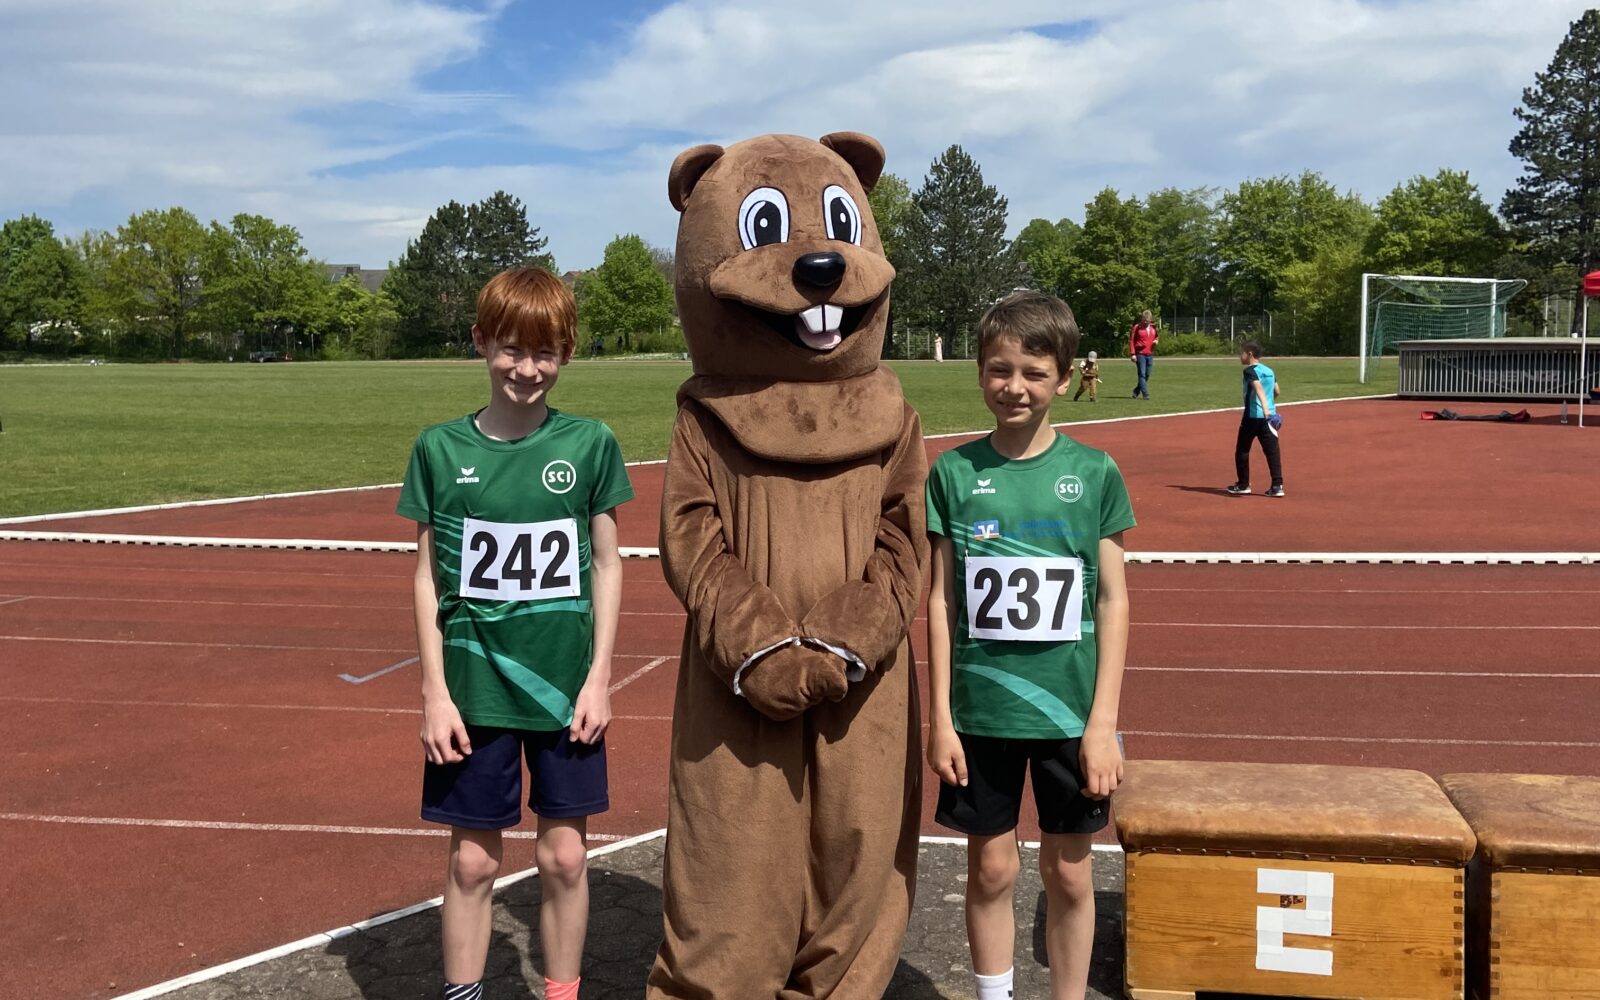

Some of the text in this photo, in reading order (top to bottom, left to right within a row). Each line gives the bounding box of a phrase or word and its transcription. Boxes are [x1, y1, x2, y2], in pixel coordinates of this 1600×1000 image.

[548, 471, 570, 483] SCI
[1059, 483, 1079, 495] SCI
[469, 530, 571, 590] 242
[974, 568, 1075, 630] 237
[1256, 868, 1334, 976] 2
